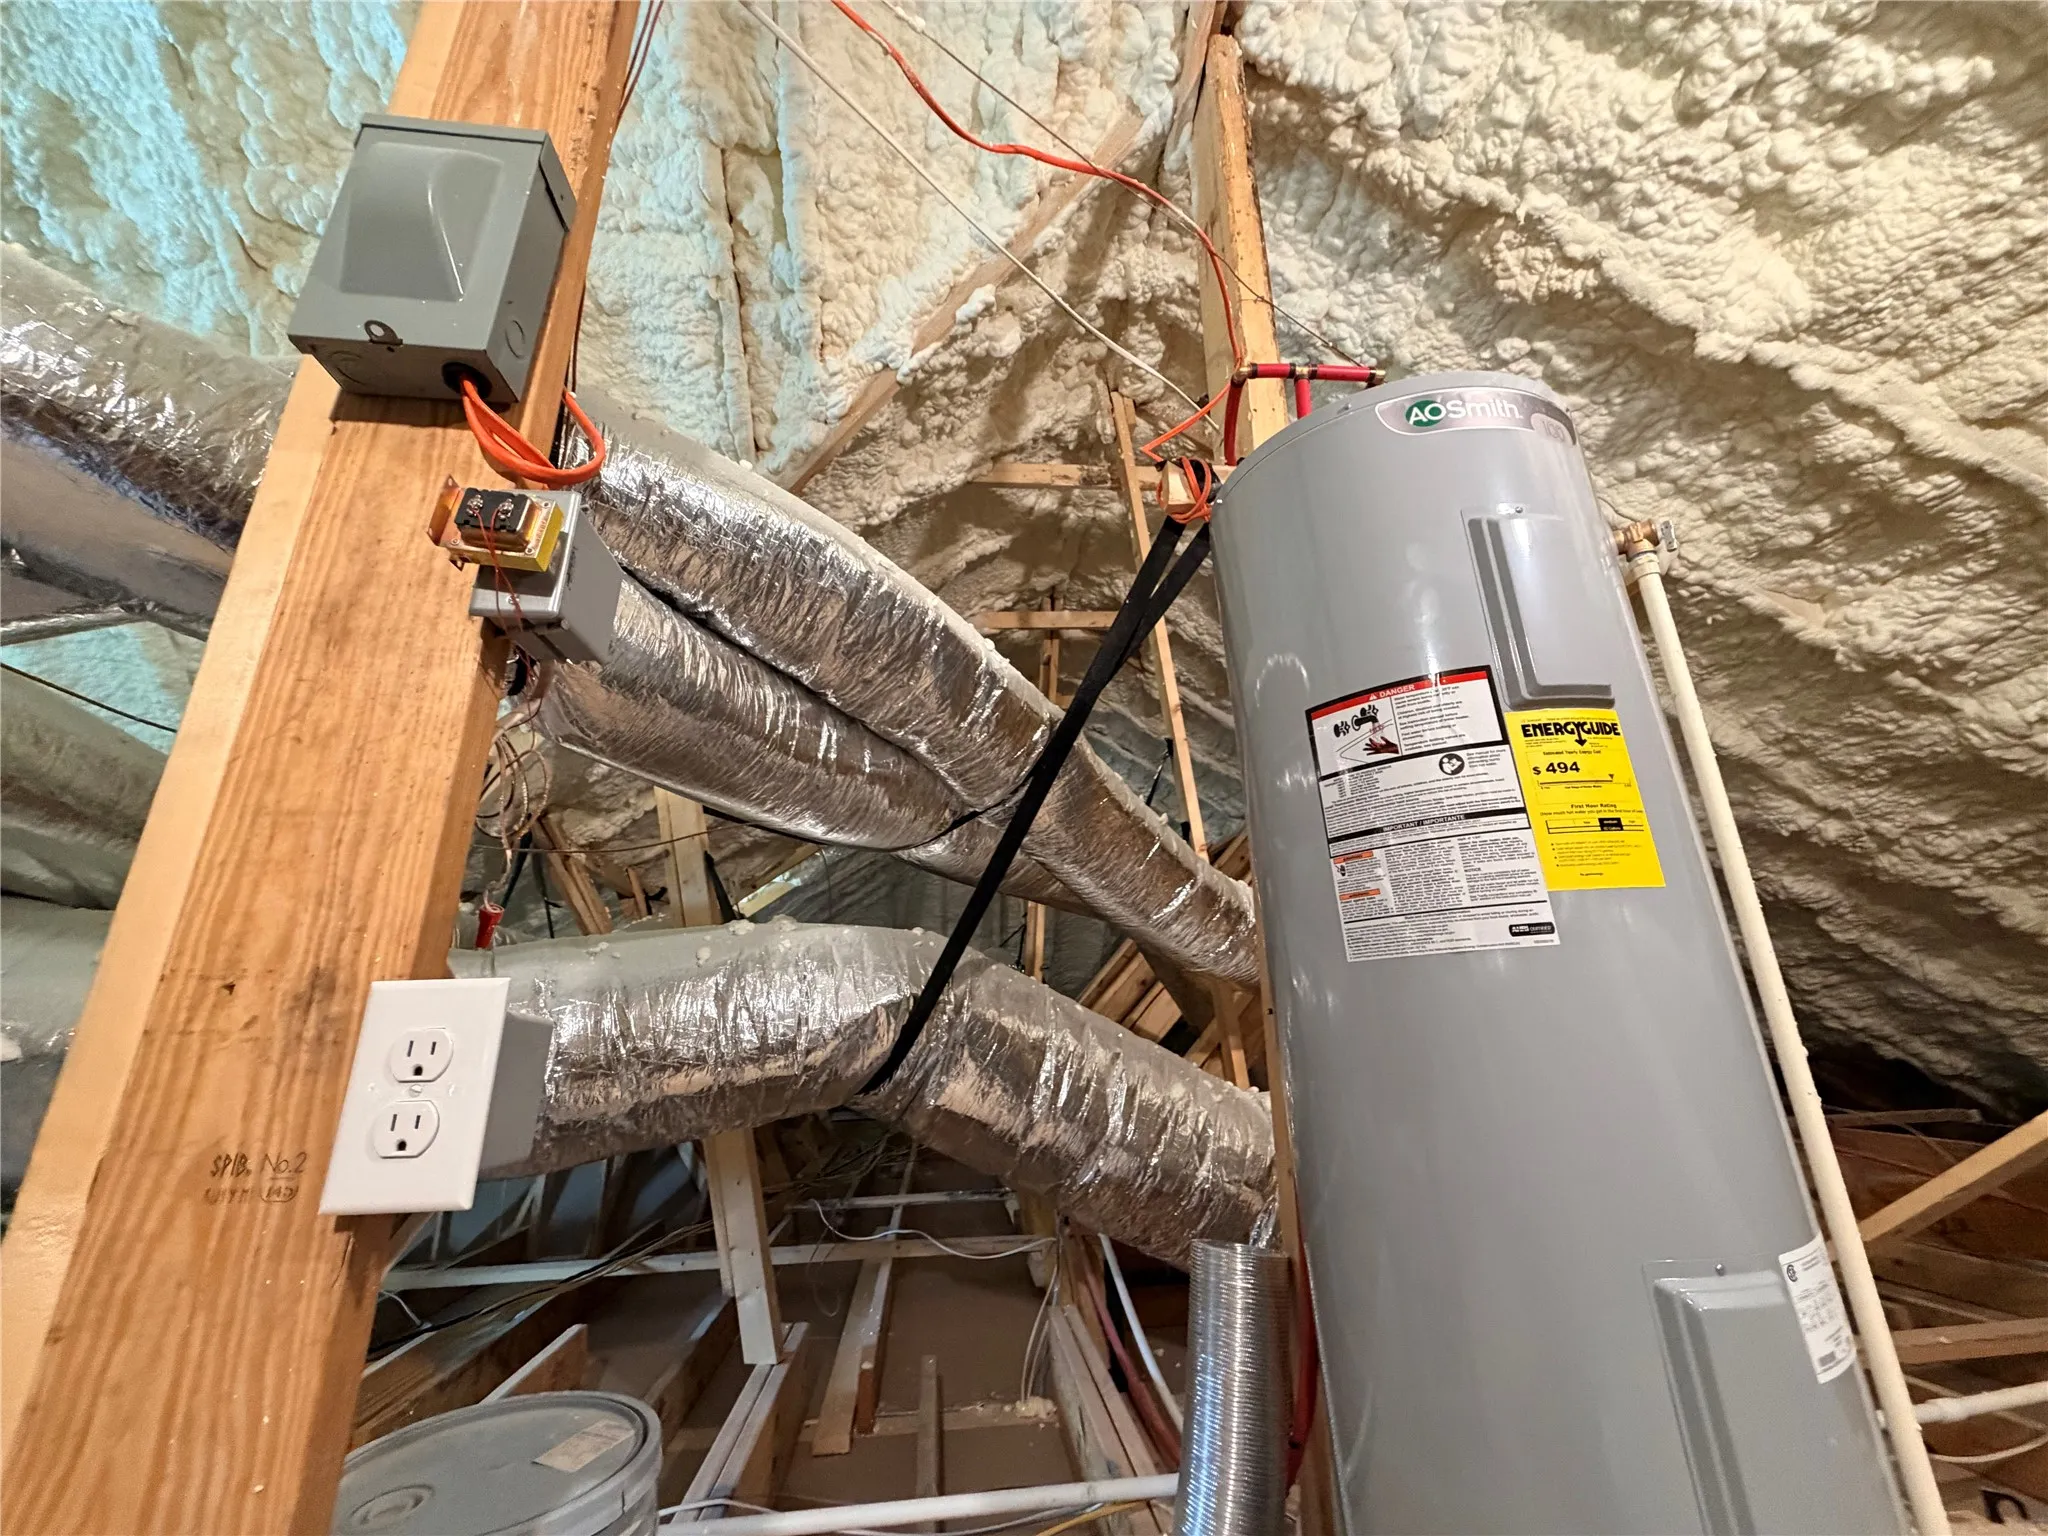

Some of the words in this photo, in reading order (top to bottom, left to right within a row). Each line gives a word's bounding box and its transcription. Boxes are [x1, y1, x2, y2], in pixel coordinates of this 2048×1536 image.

[1380, 684, 1415, 698] DANGER
[1545, 761, 1581, 774] 494
[1382, 821, 1419, 832] IMPORTANT
[1423, 815, 1465, 826] IMPORTANTE
